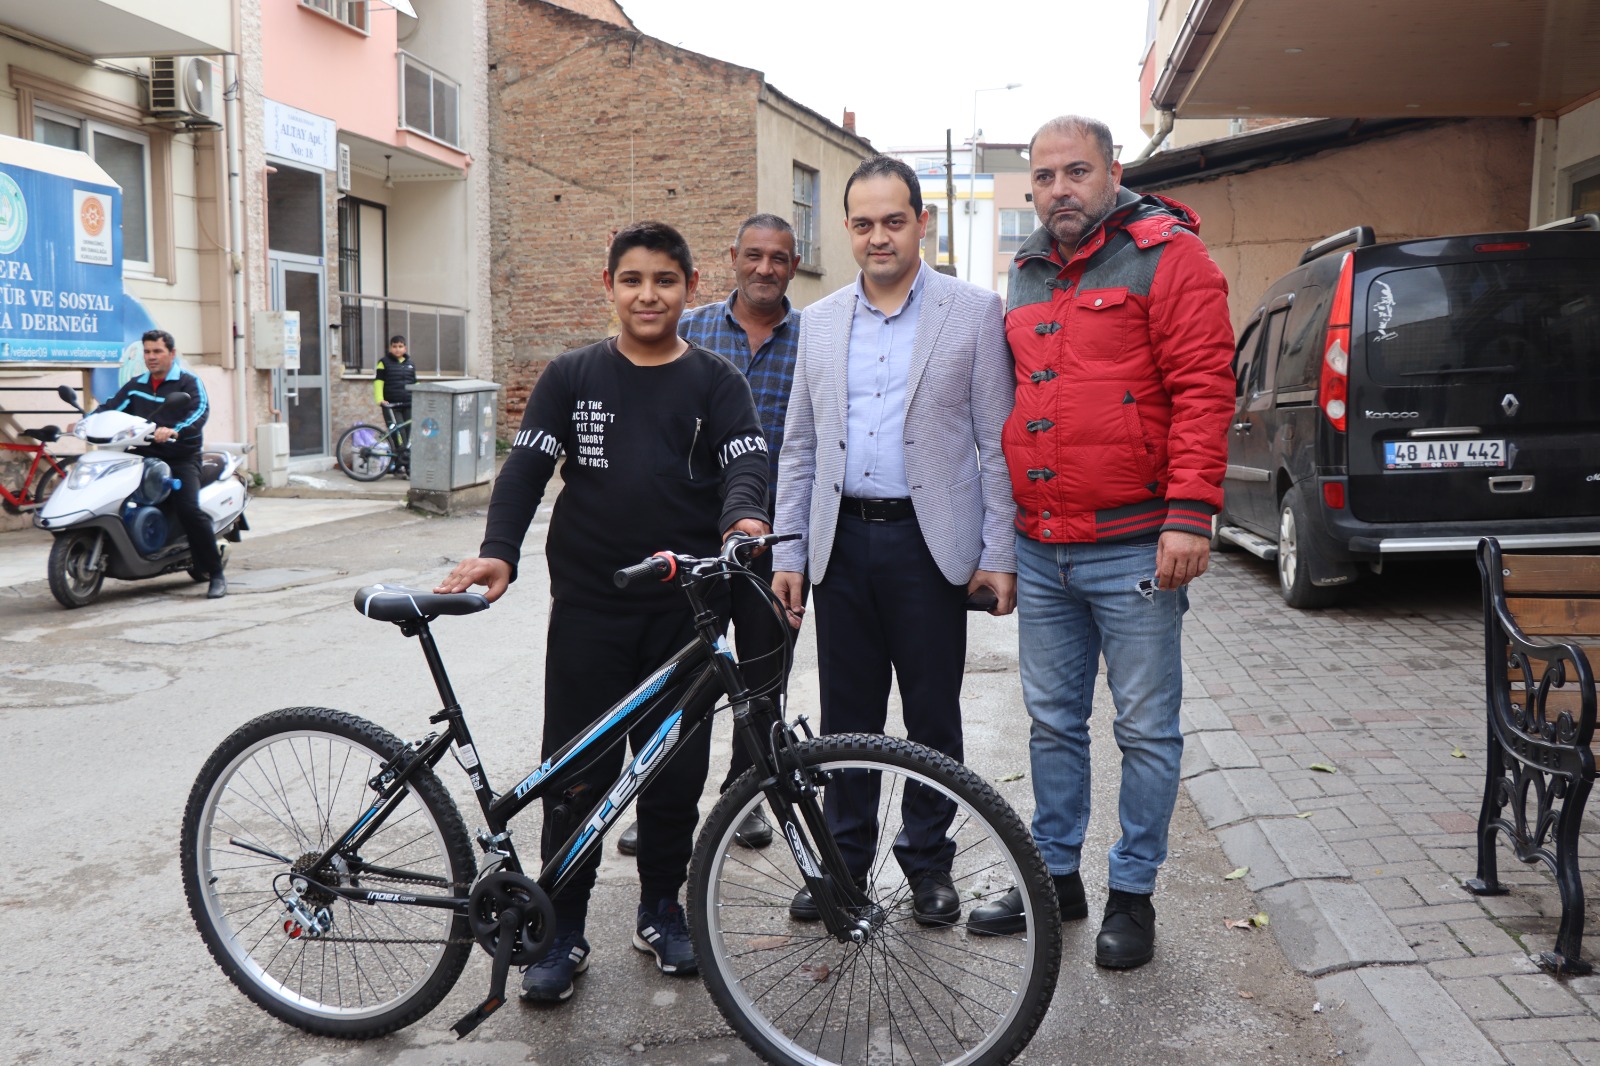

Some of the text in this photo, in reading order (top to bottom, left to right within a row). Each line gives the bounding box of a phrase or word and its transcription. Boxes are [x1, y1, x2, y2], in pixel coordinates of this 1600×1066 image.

[281, 123, 307, 140] ALTAY
[291, 142, 315, 160] No: 18
[0, 284, 114, 312] ÜR VE SOSYAL
[21, 312, 98, 333] DERNEĞİ
[576, 400, 603, 410] IF THE
[591, 411, 616, 424] DON'T
[589, 423, 605, 433] THE
[577, 434, 605, 445] THEORY
[1396, 444, 1418, 461] 48
[1427, 443, 1459, 460] AAV
[1467, 442, 1501, 460] 442
[589, 457, 609, 469] FACTS
[514, 757, 552, 801] TITAN
[583, 730, 667, 834] TEC
